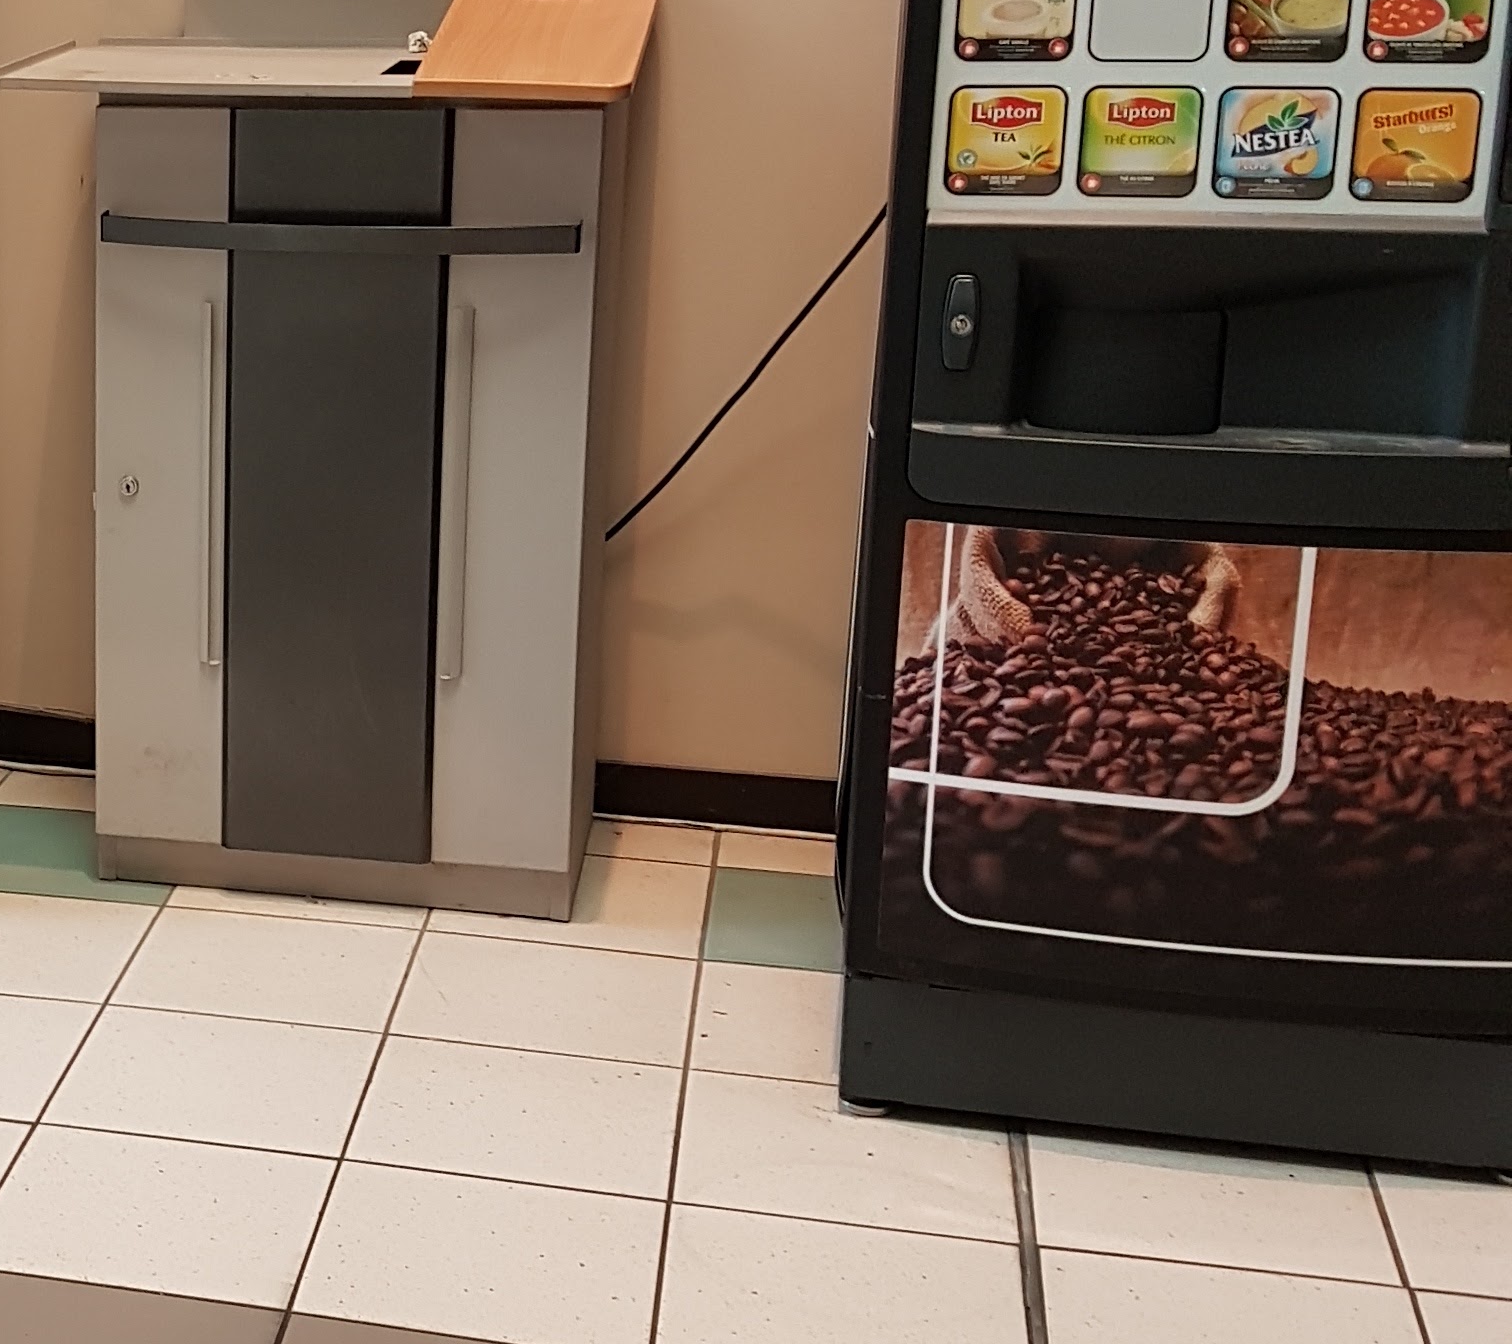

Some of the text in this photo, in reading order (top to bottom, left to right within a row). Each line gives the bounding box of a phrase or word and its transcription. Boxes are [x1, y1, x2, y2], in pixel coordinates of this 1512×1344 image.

[977, 104, 1038, 123] Lipton
[1113, 104, 1171, 122] Lipton
[992, 132, 1016, 143] TEA
[1104, 134, 1176, 145] THÉ CITRON
[1235, 129, 1316, 153] NESTEA
